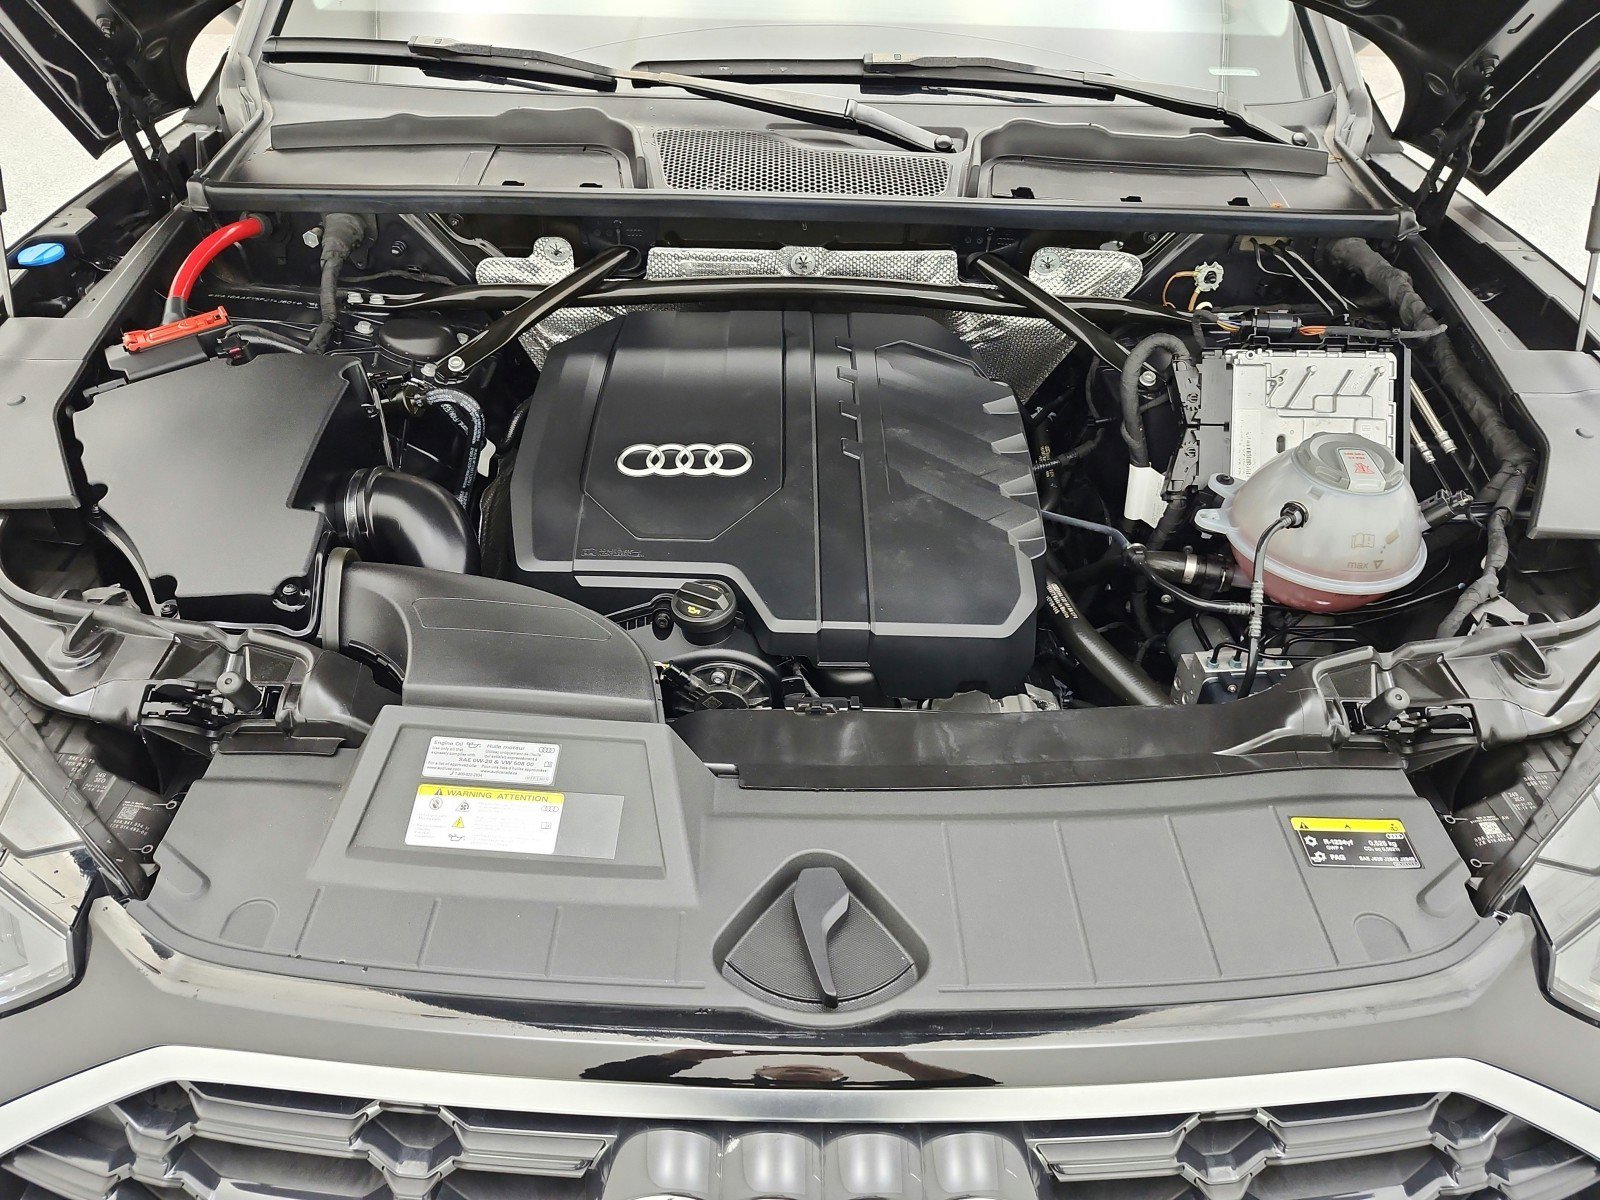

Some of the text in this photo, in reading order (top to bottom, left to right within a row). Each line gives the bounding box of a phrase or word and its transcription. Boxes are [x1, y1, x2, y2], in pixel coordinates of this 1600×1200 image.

[1347, 561, 1369, 569] max
[447, 789, 549, 802] WARNING ATTENTION
[1323, 838, 1354, 847] R-1234yf
